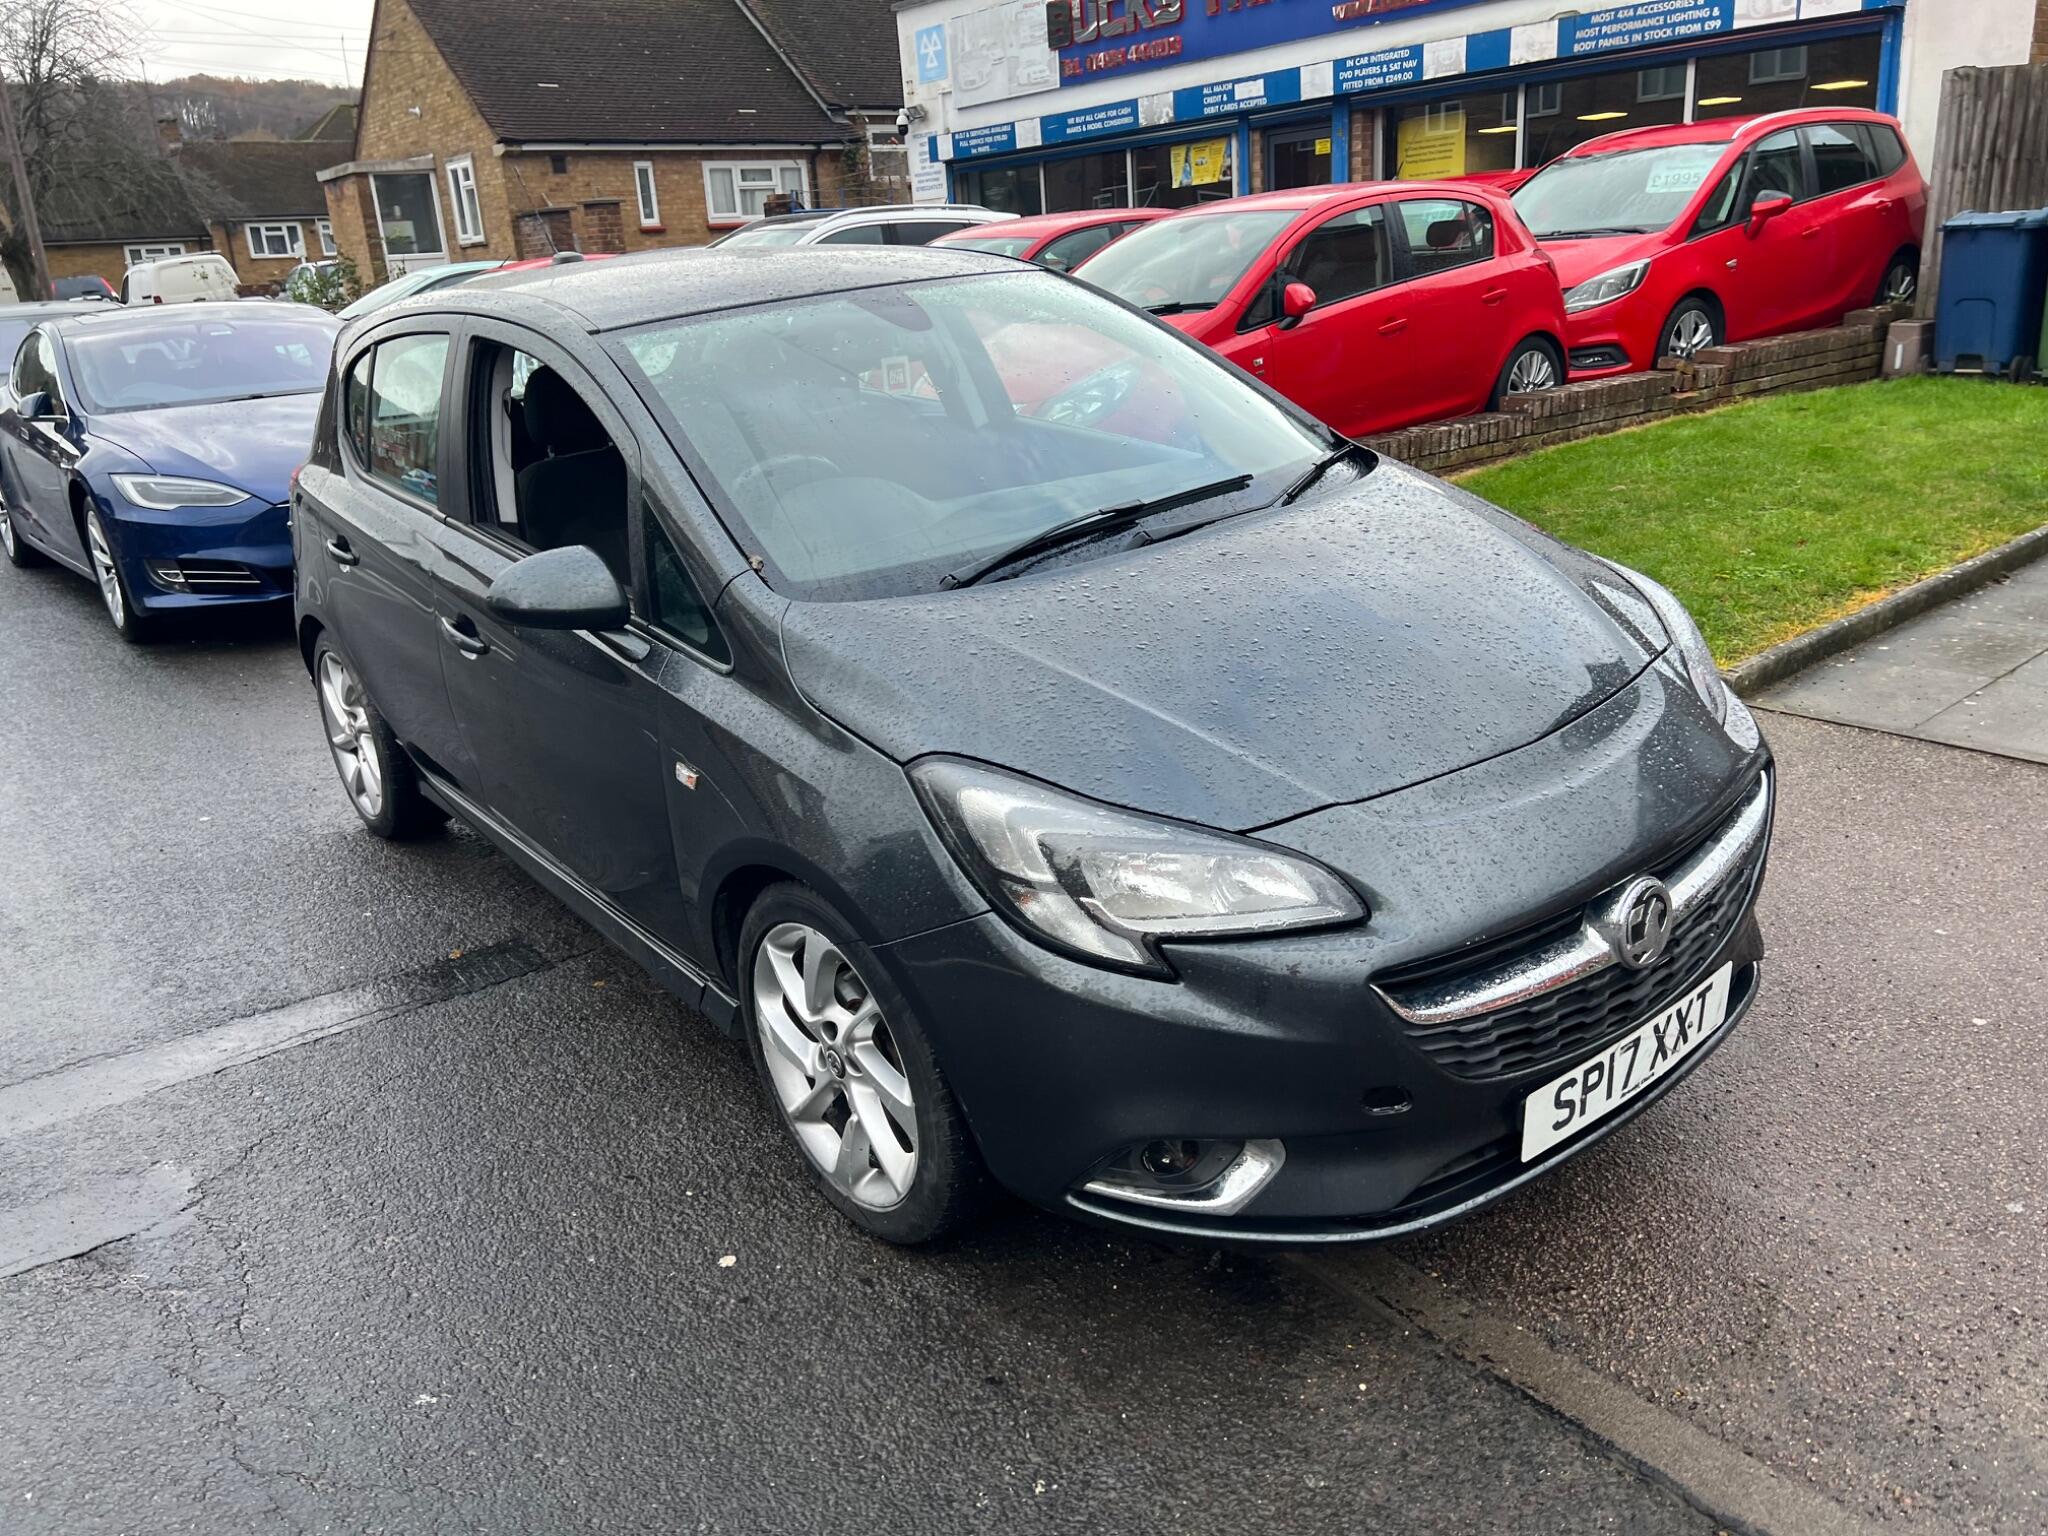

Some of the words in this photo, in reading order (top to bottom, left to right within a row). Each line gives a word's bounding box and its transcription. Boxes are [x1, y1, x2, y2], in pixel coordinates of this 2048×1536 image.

[1591, 10, 1615, 24] MOST
[1617, 8, 1634, 19] 4X4
[1636, 0, 1695, 15] ACCESSORIES
[1575, 27, 1600, 39] MOST
[1602, 16, 1665, 35] PERFORMANCE
[1667, 8, 1710, 24] LIGHTING
[1712, 7, 1720, 17] &
[1573, 41, 1596, 53] BODY
[1598, 34, 1630, 48] PANELS
[1631, 32, 1642, 42] IN
[1644, 28, 1673, 41] STOCK
[1675, 22, 1702, 36] FROM
[1704, 19, 1721, 31] £99
[1355, 56, 1368, 66] CAR
[1369, 49, 1410, 63] INTEGRATED
[1339, 71, 1353, 79] DVD
[1354, 65, 1380, 76] PLAYERS
[1389, 62, 1401, 71] SAT
[1402, 59, 1418, 69] NAV
[1213, 82, 1233, 92] MAJOR
[1343, 80, 1363, 90] FITTED
[1364, 77, 1384, 87] FROM
[1203, 94, 1222, 105] CREDIT
[1223, 93, 1228, 101] &
[1203, 105, 1219, 115] DEBIT
[1220, 102, 1238, 112] CARDS
[1239, 97, 1268, 109] ACCEPTED
[1075, 115, 1085, 124] BUY
[1085, 114, 1094, 122] ALL
[1094, 111, 1107, 120] CARS
[1107, 109, 1117, 117] FOR
[1117, 106, 1132, 116] CASH
[1552, 1035, 1641, 1131] SP17
[1650, 982, 1713, 1073] XXT
